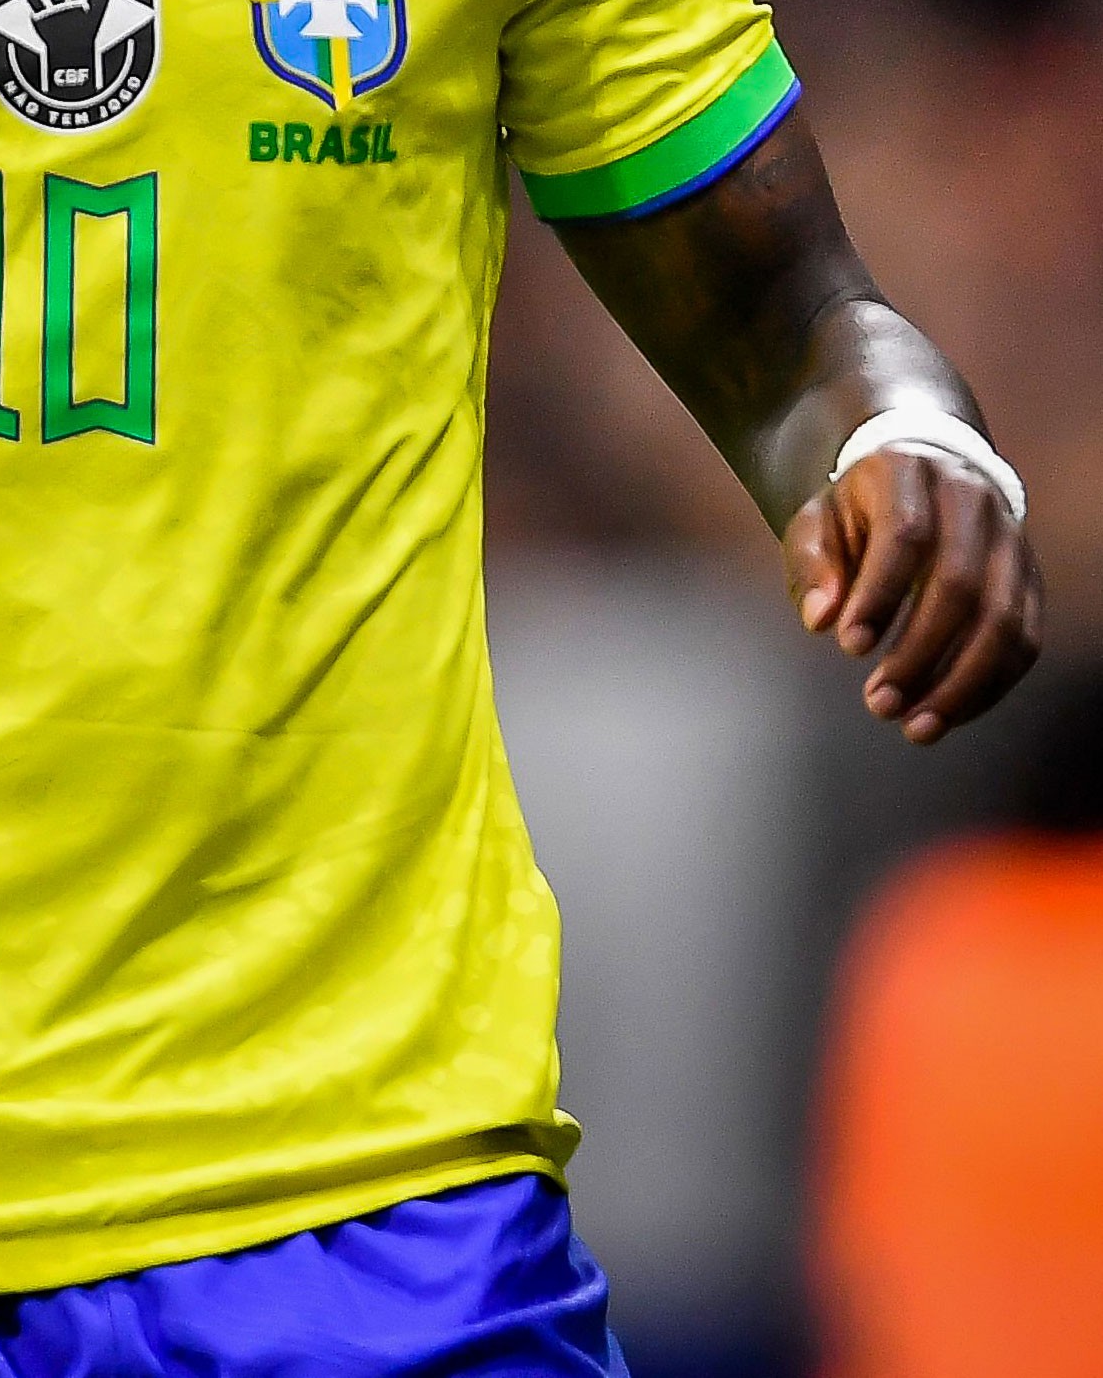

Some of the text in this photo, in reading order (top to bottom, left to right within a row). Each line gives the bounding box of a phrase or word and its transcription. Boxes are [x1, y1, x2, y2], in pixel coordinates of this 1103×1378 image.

[53, 68, 90, 87] CBF
[48, 110, 90, 126] TEM
[249, 122, 397, 163] BRASIL
